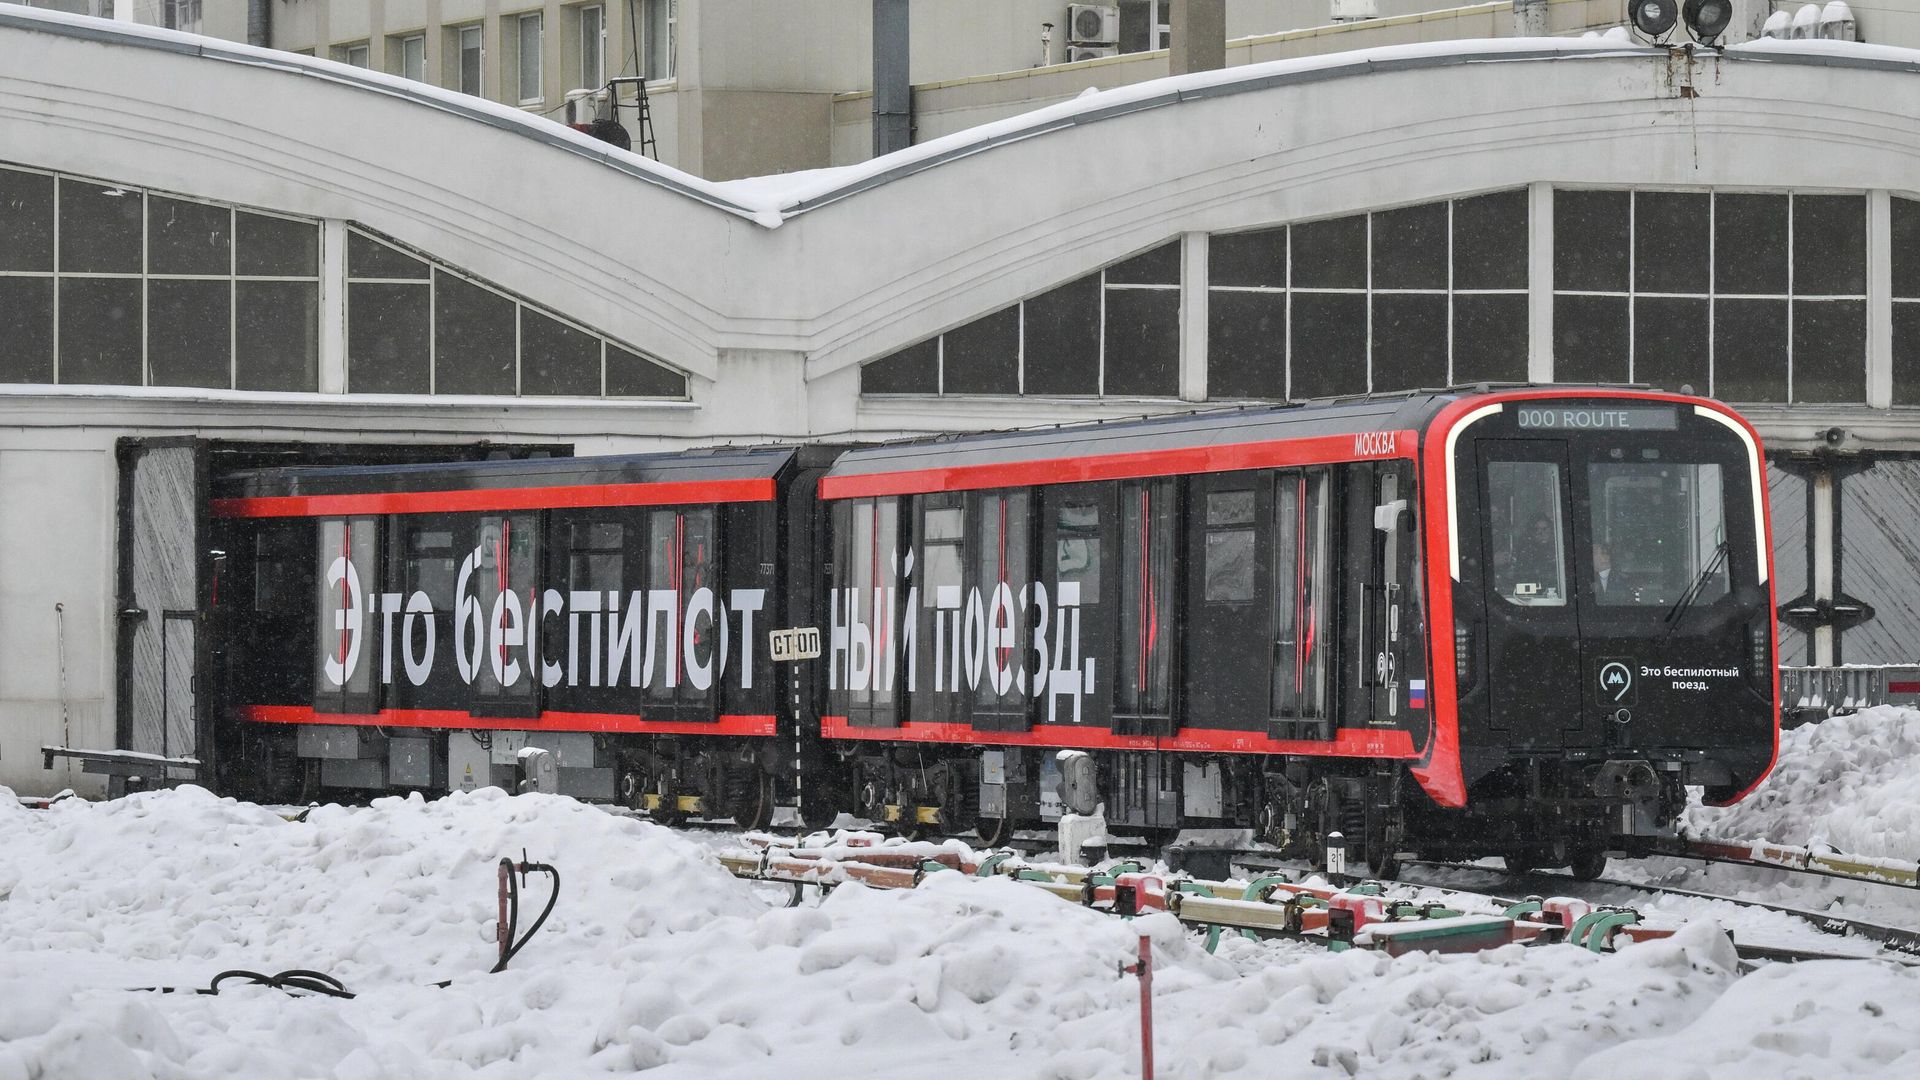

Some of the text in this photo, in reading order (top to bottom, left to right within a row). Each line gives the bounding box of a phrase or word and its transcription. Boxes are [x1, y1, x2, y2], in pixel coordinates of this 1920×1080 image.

[1563, 411, 1630, 428] ROUTE
[1354, 431, 1396, 457] МОСКВА
[325, 544, 766, 690] Это беспилот
[773, 632, 819, 656] СТОП
[935, 581, 1096, 722] поезд.
[1640, 665, 1740, 677] Это беспилотный
[1672, 680, 1710, 692] поезд.
[1331, 853, 1336, 863] 2
